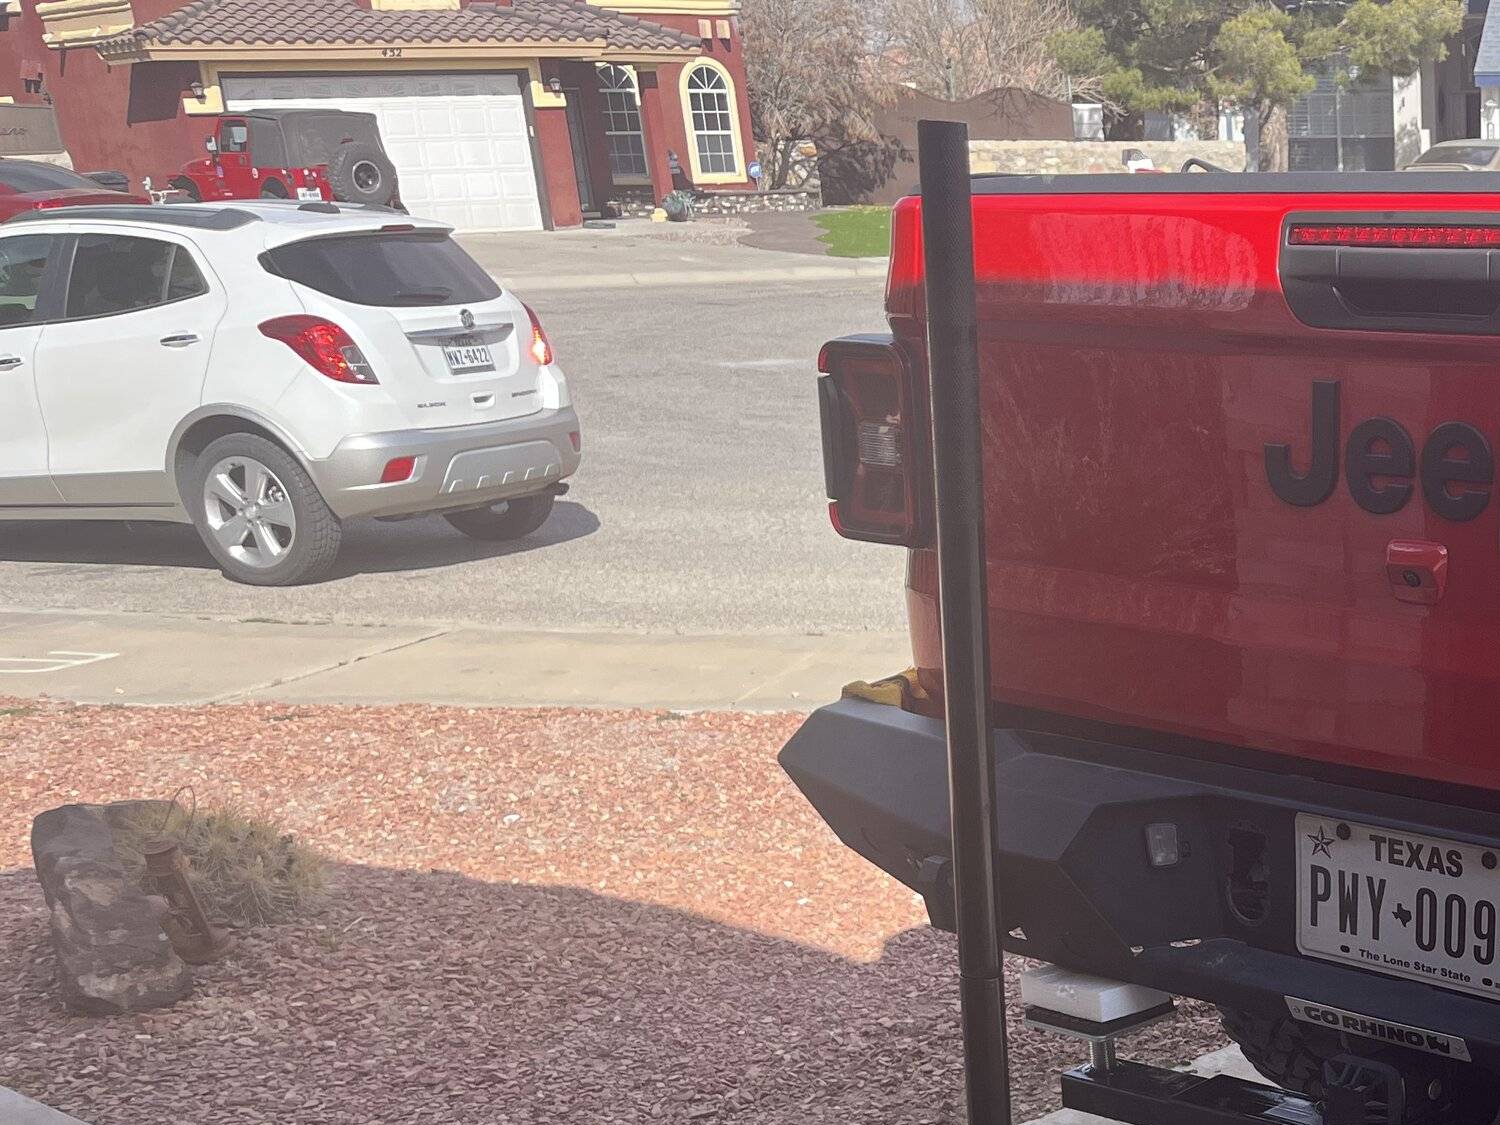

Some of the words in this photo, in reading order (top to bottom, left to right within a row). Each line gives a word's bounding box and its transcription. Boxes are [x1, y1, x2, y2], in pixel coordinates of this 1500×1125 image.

[1369, 834, 1464, 878] TEXAS
[1359, 949, 1380, 962] The
[1383, 954, 1411, 969] Lone
[1413, 961, 1438, 975] Star
[1440, 966, 1471, 983] State
